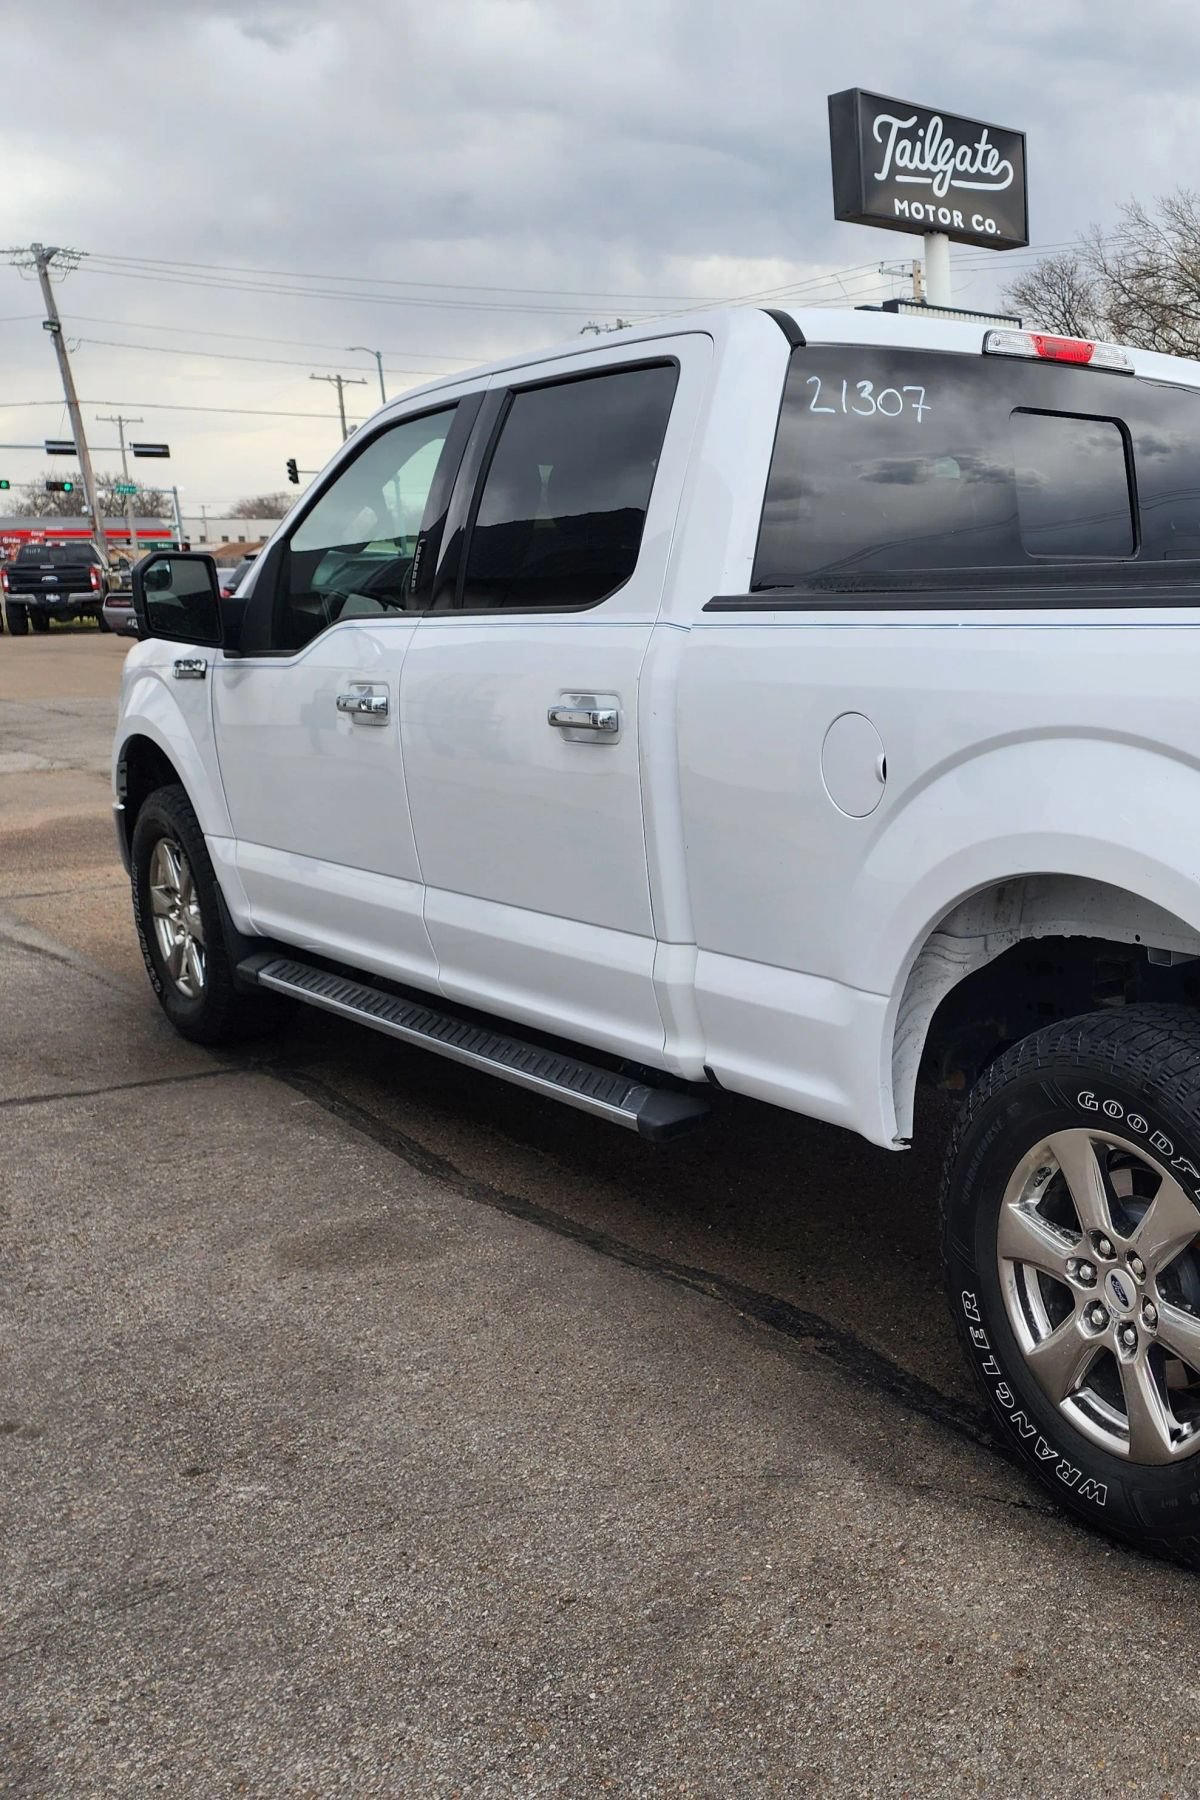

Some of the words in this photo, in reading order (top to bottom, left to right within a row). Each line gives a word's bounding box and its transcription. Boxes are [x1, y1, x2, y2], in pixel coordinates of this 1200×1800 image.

[873, 114, 1014, 197] Tailgate
[894, 198, 964, 229] MOTOR
[971, 214, 1001, 235] CO.
[806, 375, 932, 424] 21307
[961, 1290, 1108, 1506] WRANGLER
